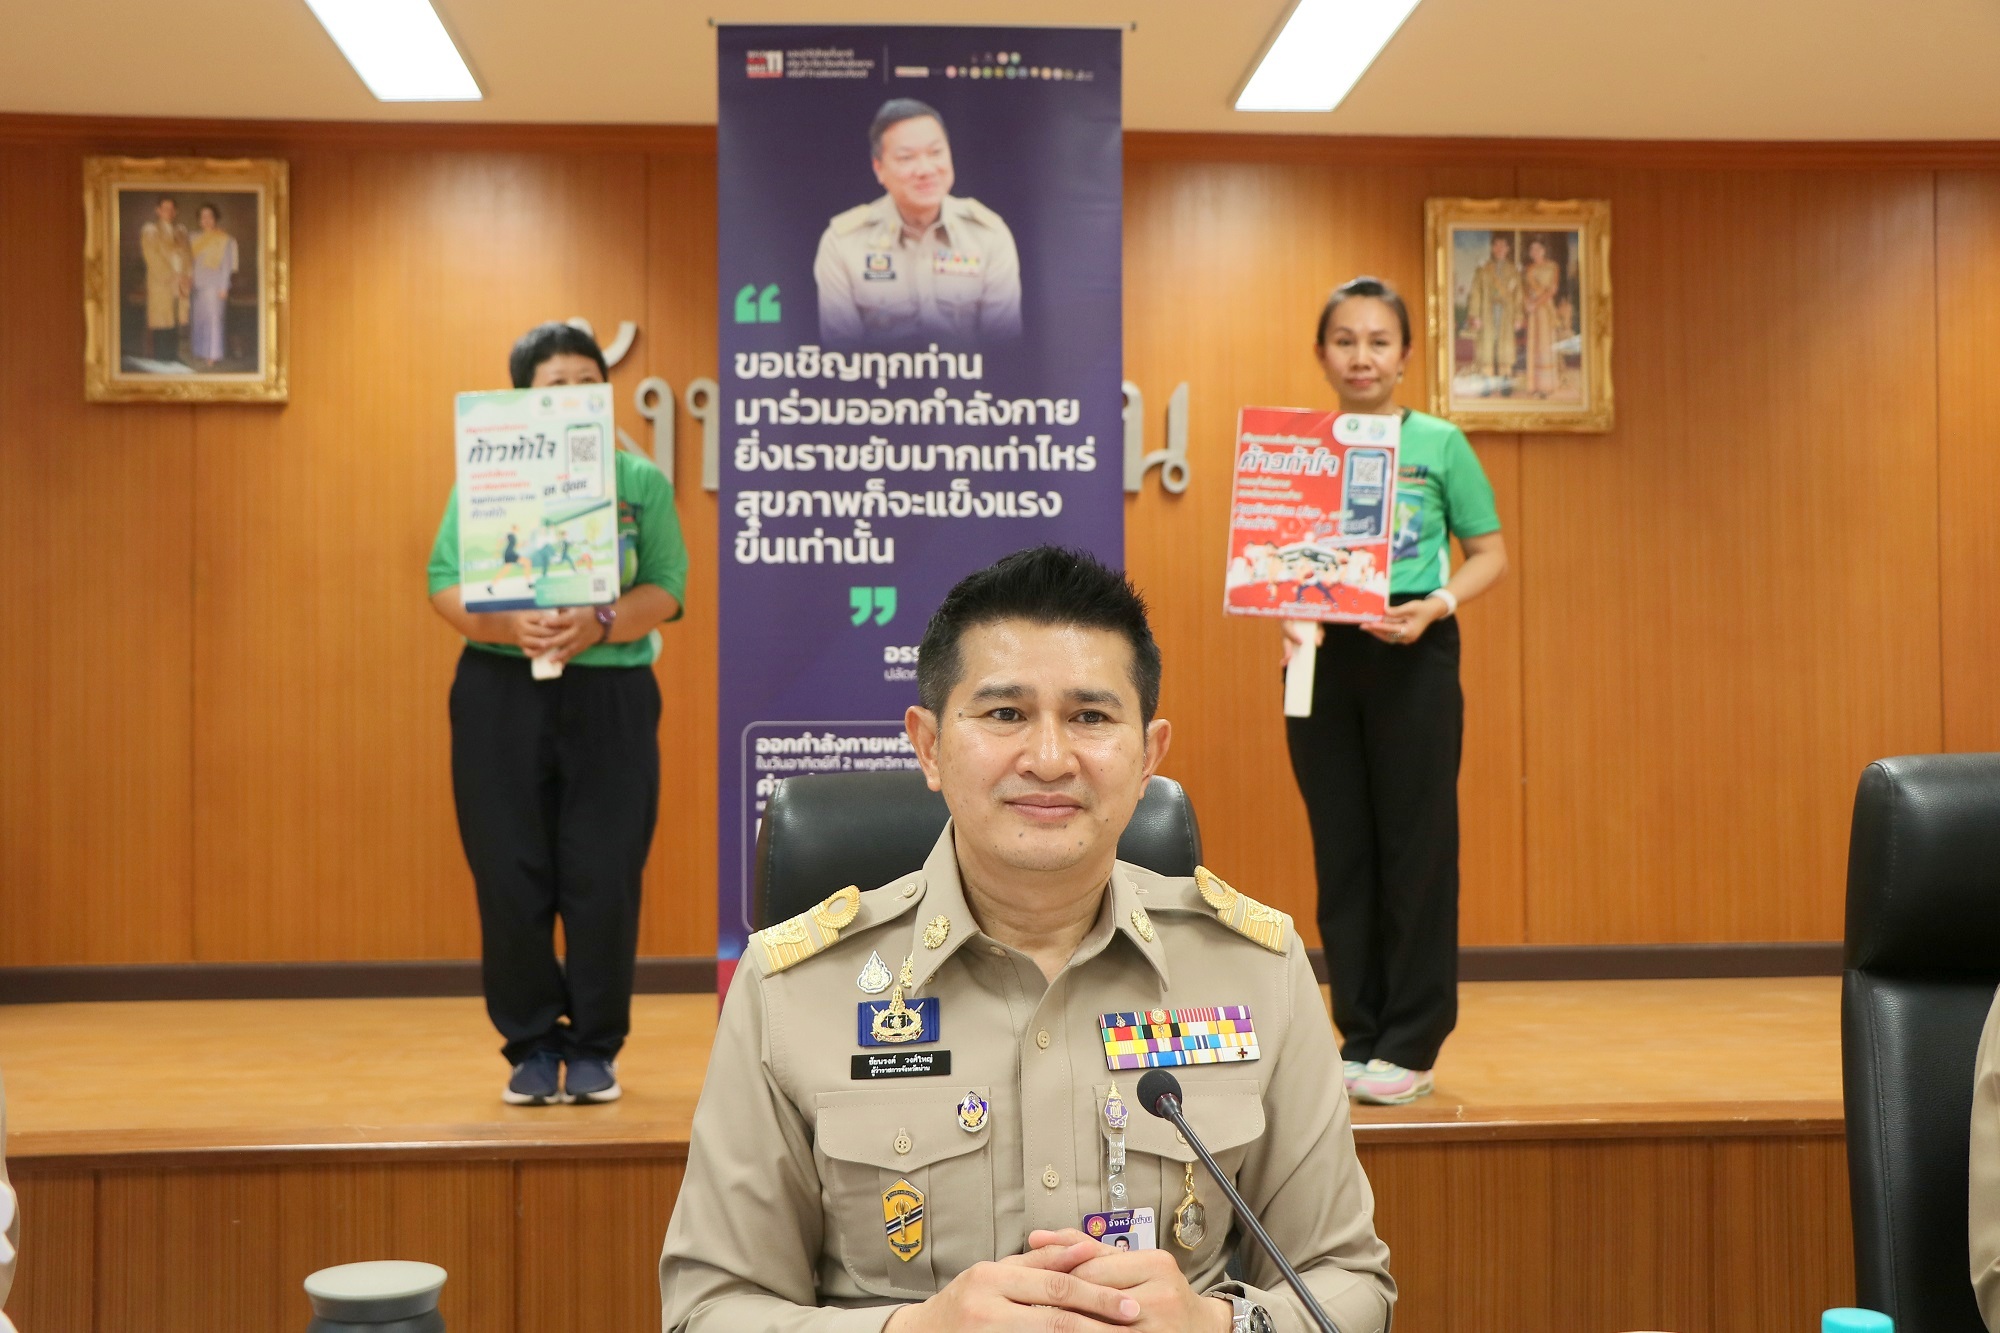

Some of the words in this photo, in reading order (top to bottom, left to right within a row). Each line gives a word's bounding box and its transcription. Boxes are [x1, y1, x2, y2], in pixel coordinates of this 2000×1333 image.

[735, 343, 983, 389] ขอเชิญทุกท่าน
[735, 388, 1080, 426] มาร่วมออกกำลังกาย
[735, 430, 1096, 472] ยิ่งเราขยับมากเท่าไหร่
[735, 478, 1063, 525] สุขภาพก็จะแข็งแรง
[735, 519, 894, 564] ขึ้นเท่านั้น
[842, 757, 852, 770] 2
[1108, 1215, 1153, 1228] จังหวัดน่าน
